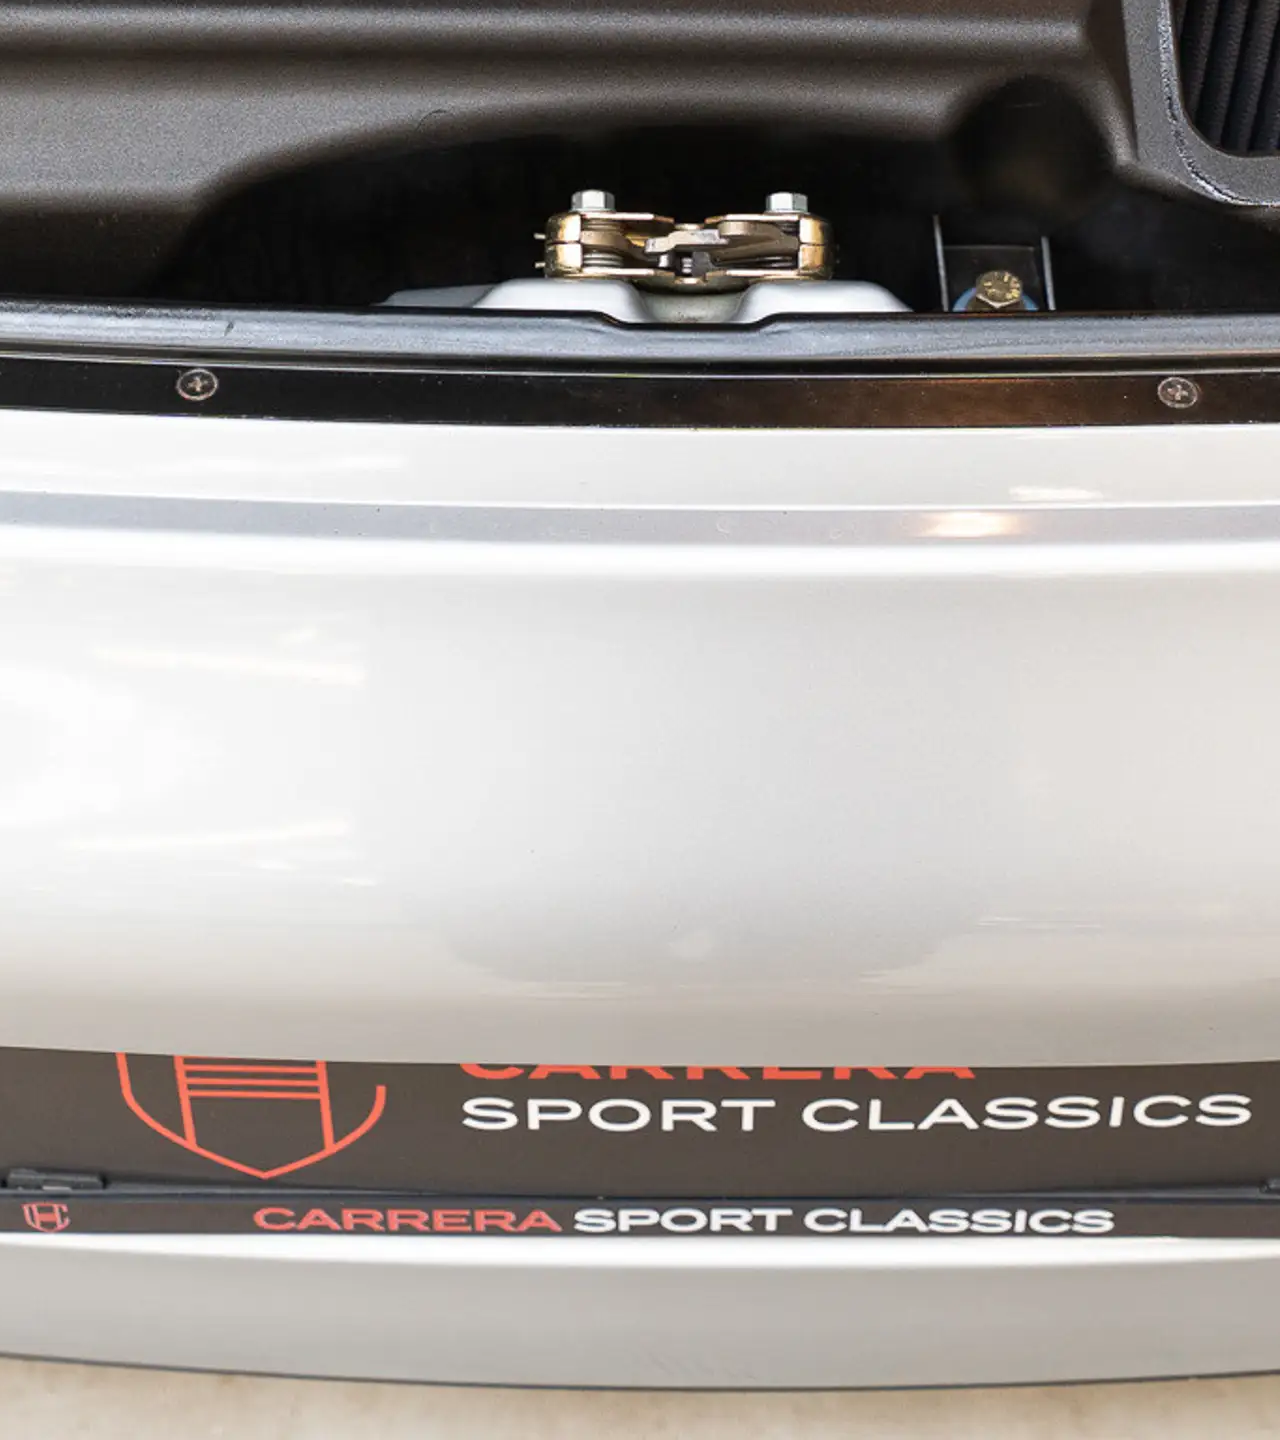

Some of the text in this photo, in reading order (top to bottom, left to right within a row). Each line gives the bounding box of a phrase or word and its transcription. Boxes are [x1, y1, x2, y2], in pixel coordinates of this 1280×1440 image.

[462, 1094, 1252, 1133] SPORT CLASSICS
[253, 1207, 1115, 1234] CARRERA SPORT CLASSICS
